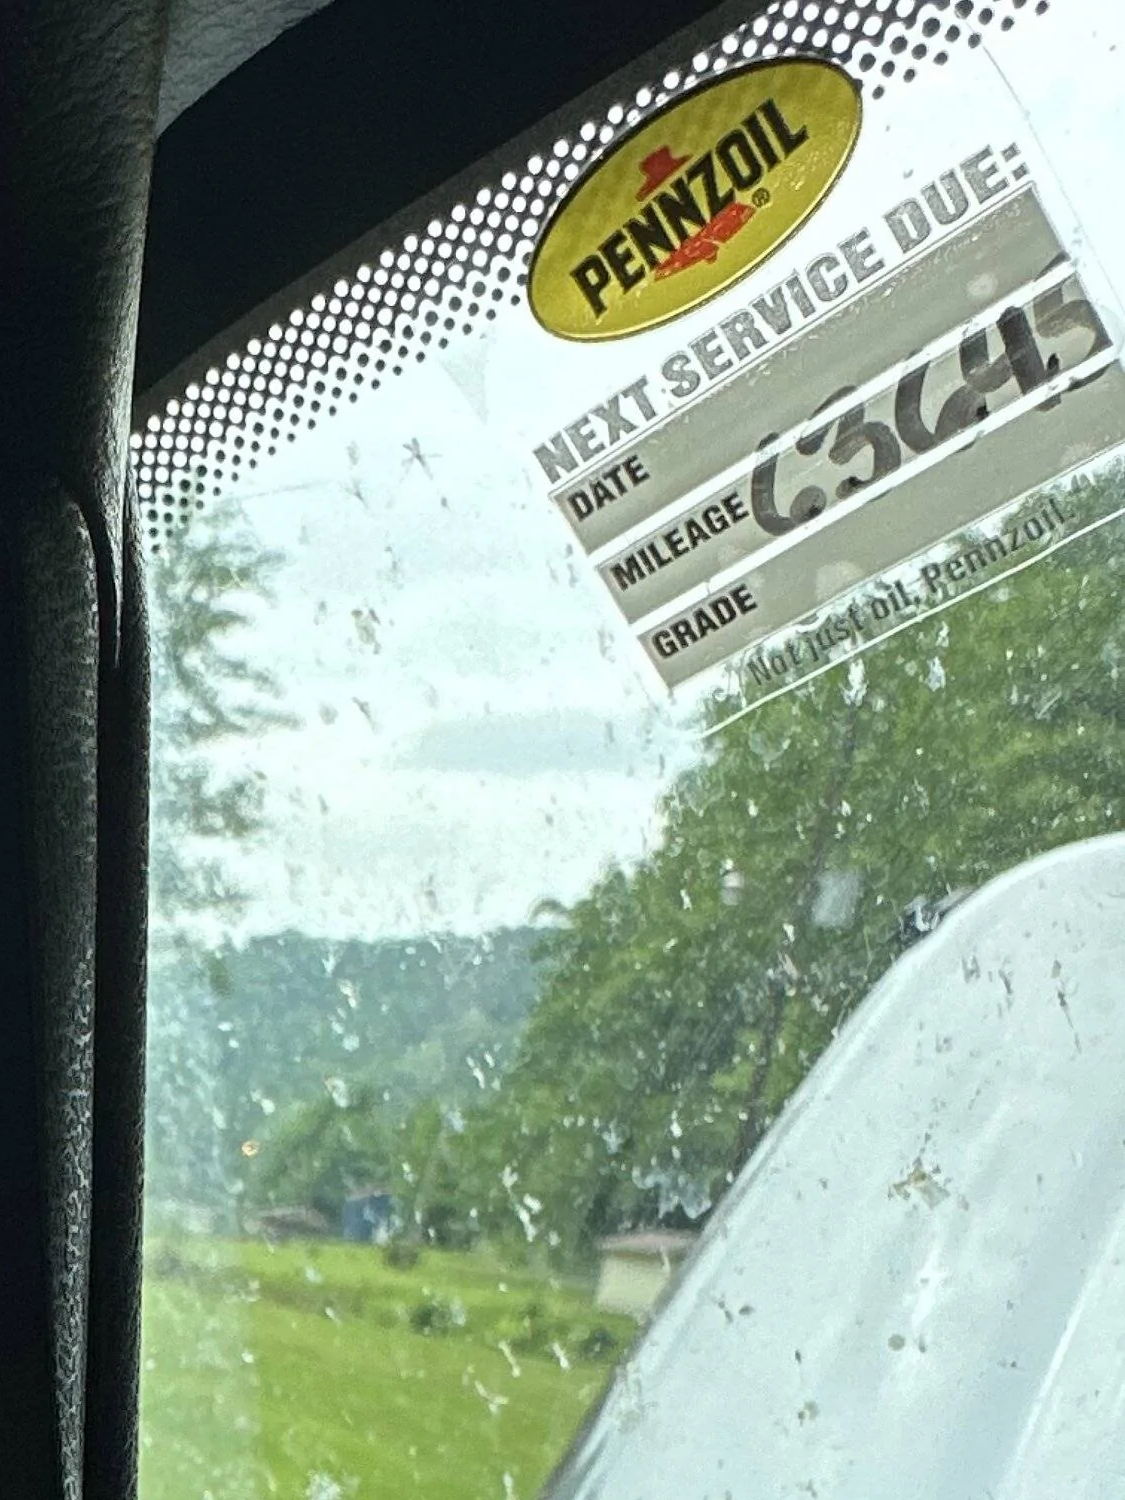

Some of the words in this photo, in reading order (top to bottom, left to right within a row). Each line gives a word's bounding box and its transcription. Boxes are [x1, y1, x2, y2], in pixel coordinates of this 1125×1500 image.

[569, 98, 811, 320] PENNZOIL
[533, 376, 660, 486] NEXT
[661, 226, 886, 399] SERVICE
[882, 141, 1029, 255] DUE:
[566, 454, 651, 523] DATE
[609, 490, 751, 592] MILEAGE
[651, 583, 759, 660] GRADE
[747, 636, 802, 686] Not
[801, 602, 865, 664] just
[920, 497, 1075, 594] Pennzoil.
